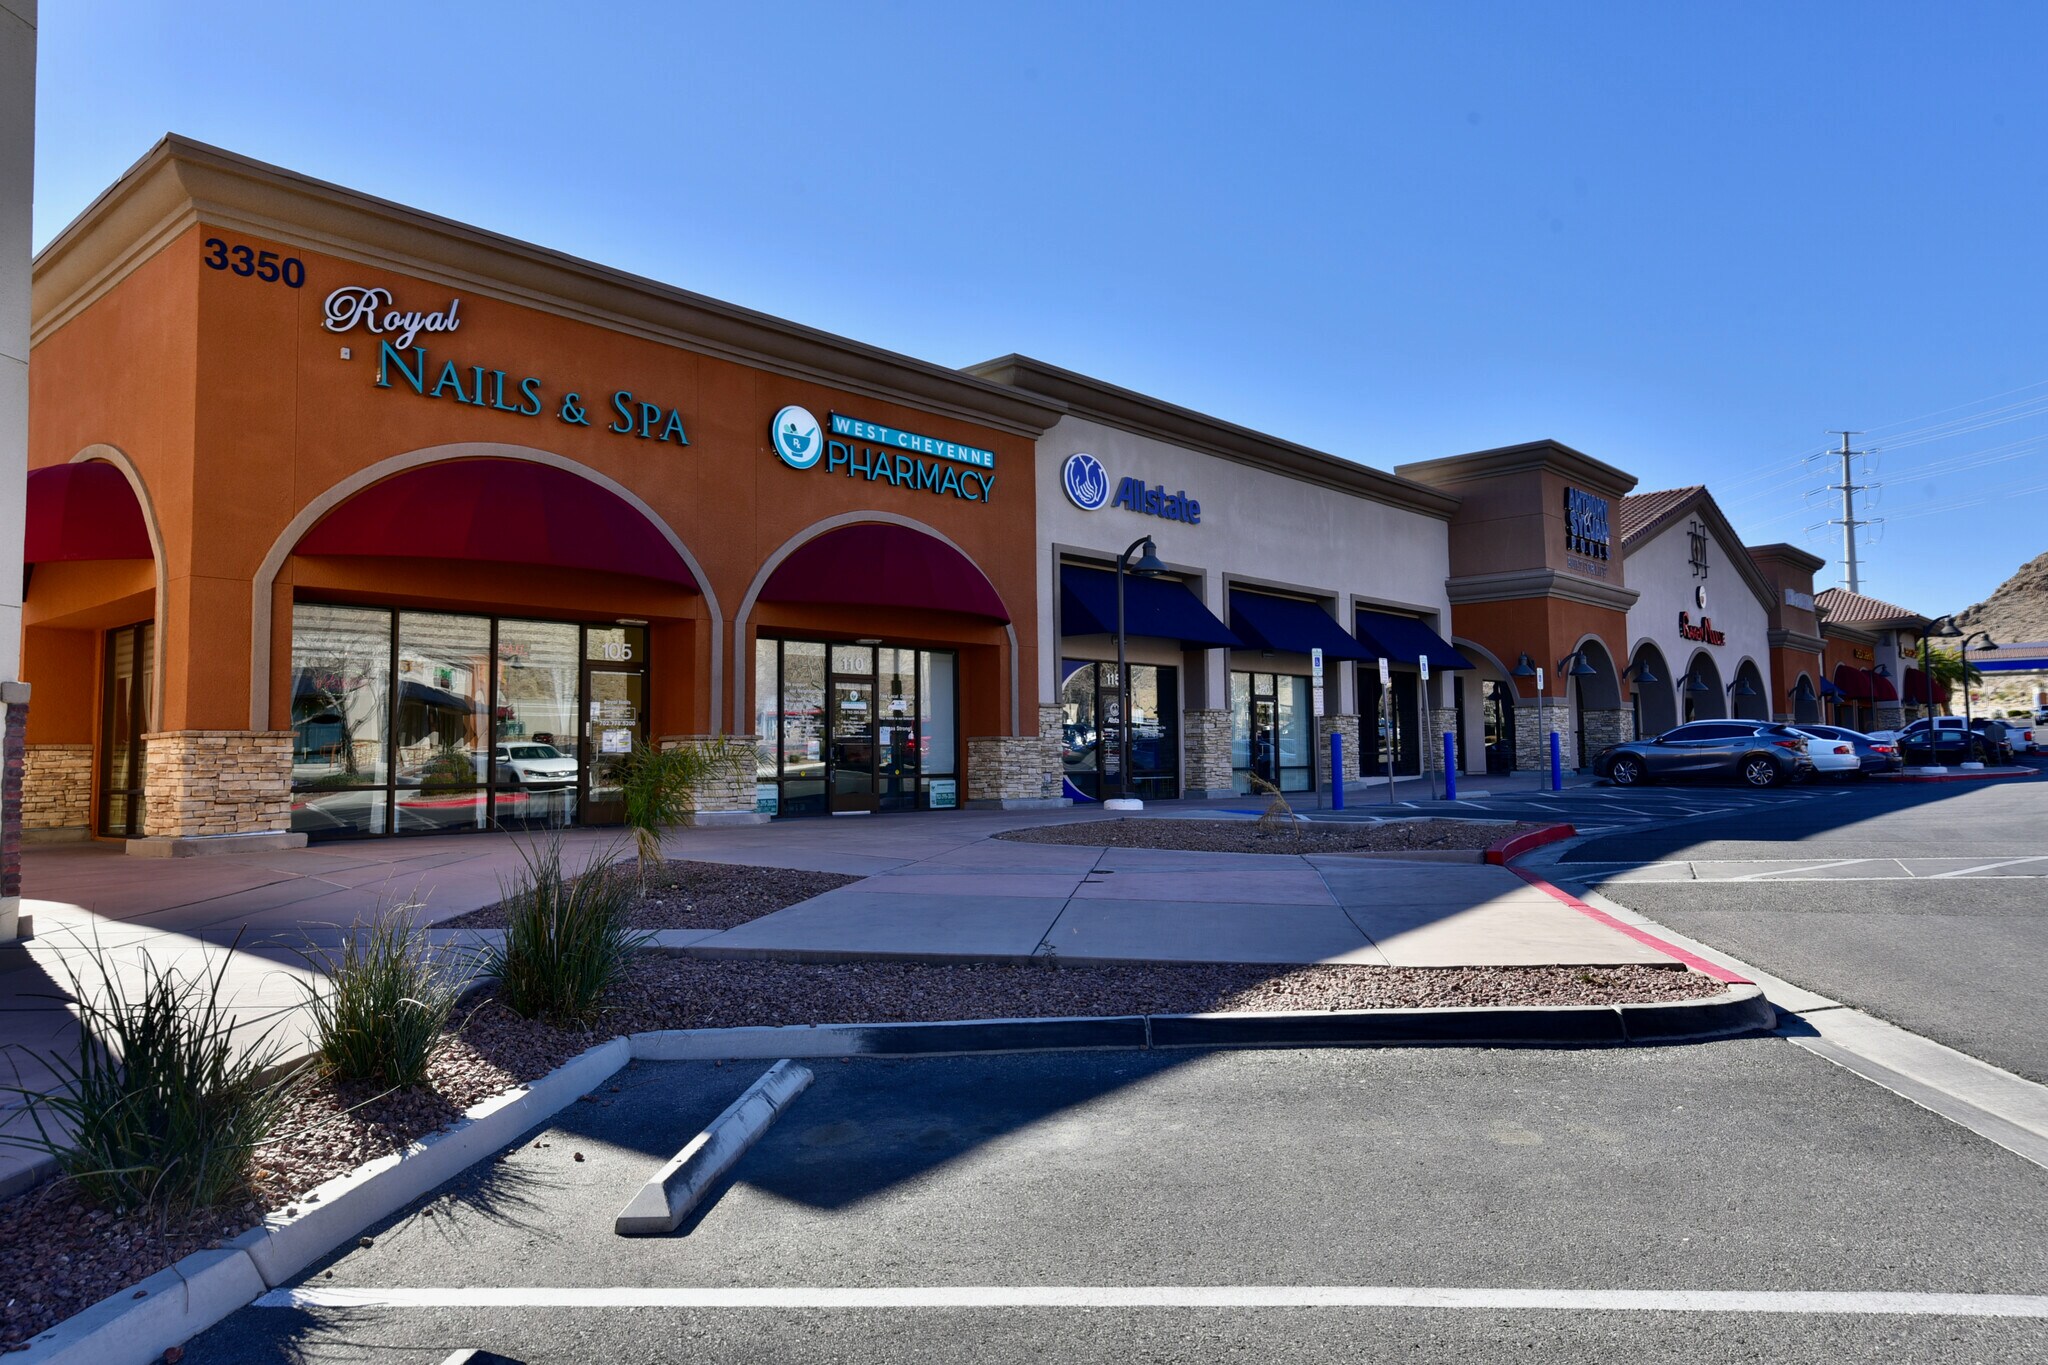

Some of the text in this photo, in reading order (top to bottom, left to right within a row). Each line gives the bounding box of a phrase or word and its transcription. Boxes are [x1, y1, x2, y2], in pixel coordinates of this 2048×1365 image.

[204, 238, 306, 288] 3350
[323, 286, 460, 349] Royal
[376, 339, 690, 446] NAILS & SPA
[835, 417, 994, 468] WEST CHEYENNE
[826, 440, 995, 503] PHARMACY
[1111, 477, 1201, 525] Allstate
[602, 643, 632, 660] 105
[842, 657, 864, 671] 110
